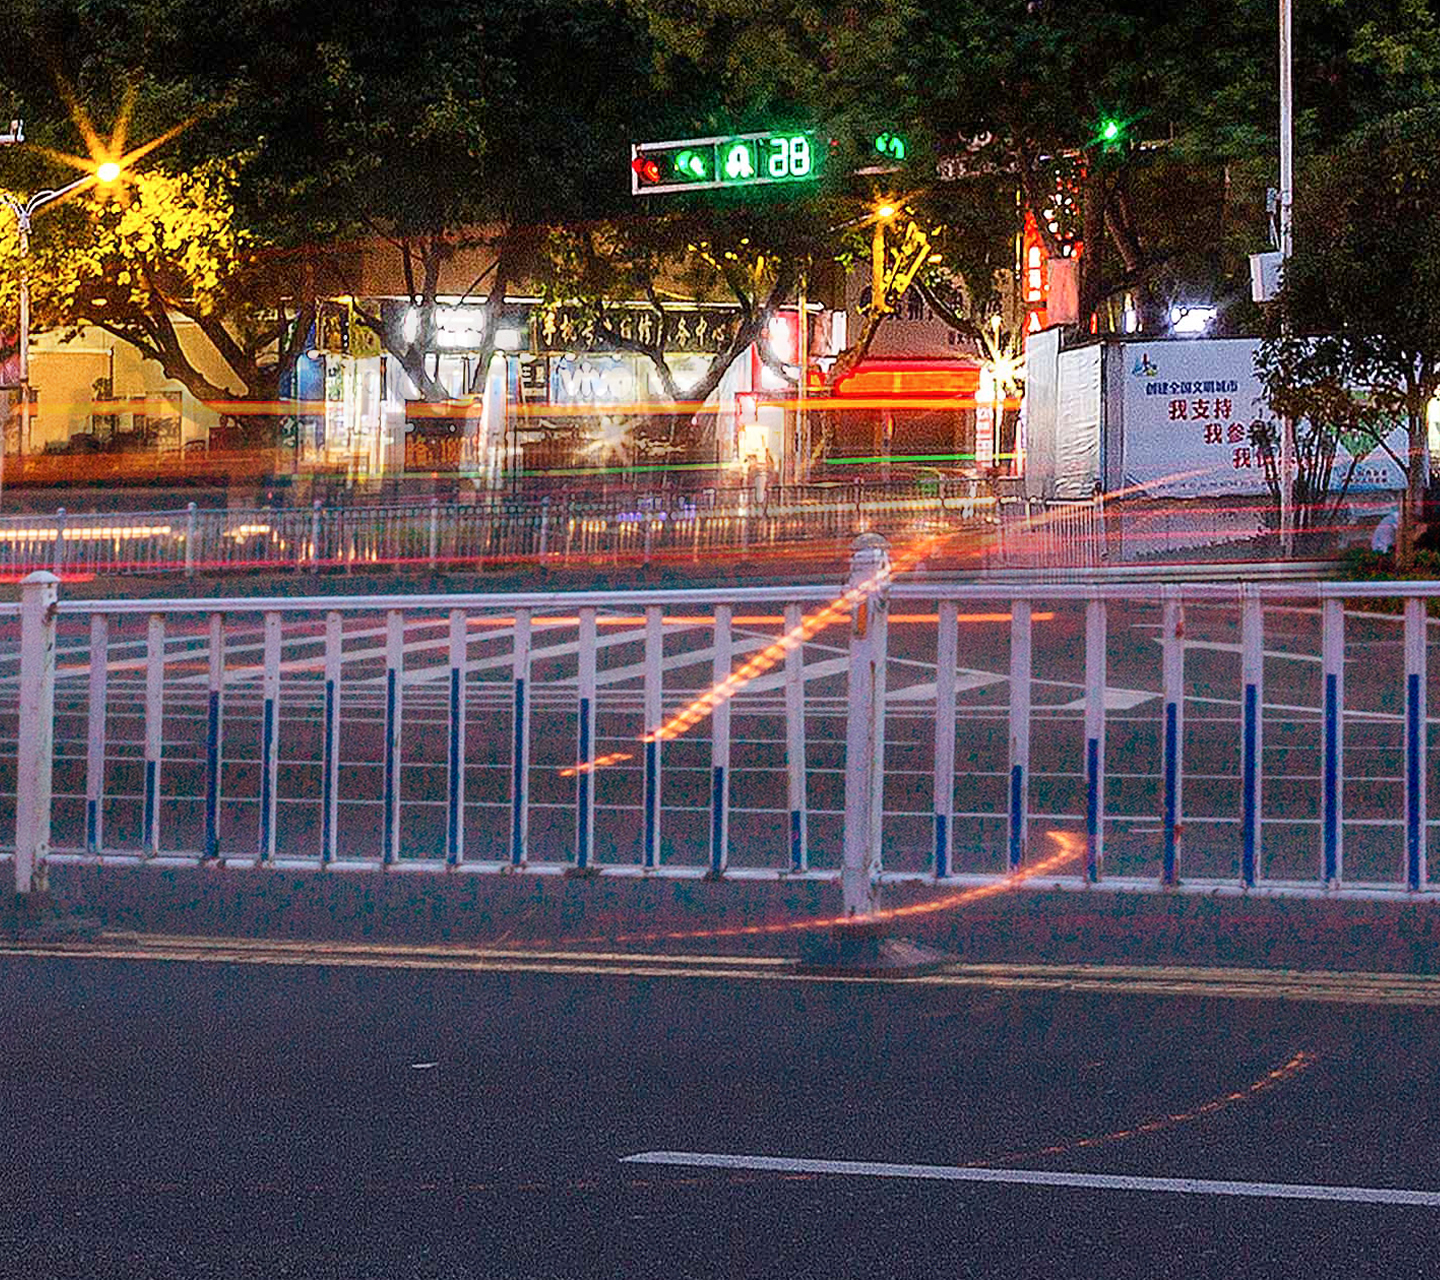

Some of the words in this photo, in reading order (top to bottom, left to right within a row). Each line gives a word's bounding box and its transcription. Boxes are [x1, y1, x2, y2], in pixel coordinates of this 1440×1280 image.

[1146, 379, 1238, 395] 创建全国文明城市
[1169, 398, 1232, 420] 我支持
[1204, 423, 1267, 444] 我参
